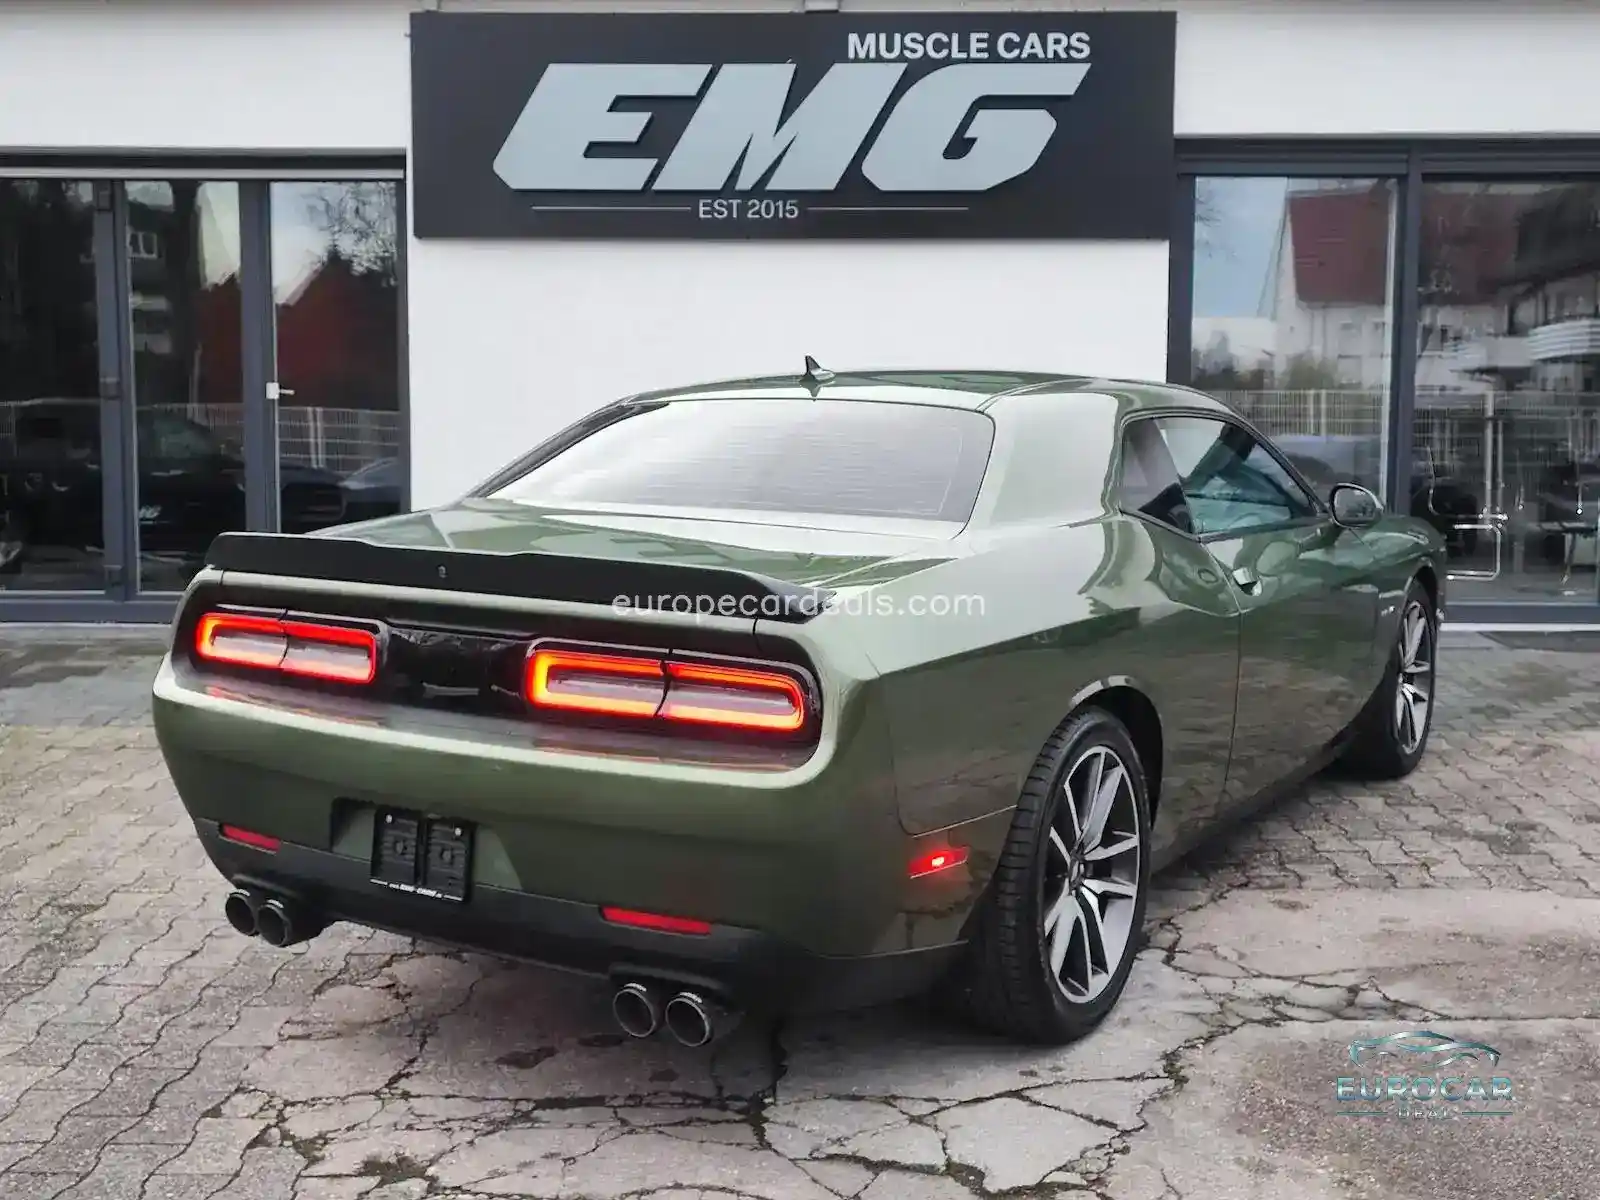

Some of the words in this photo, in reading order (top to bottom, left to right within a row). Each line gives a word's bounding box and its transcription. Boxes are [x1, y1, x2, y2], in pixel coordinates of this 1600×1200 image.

[847, 32, 990, 60] MUSCLE
[996, 32, 1091, 59] CARS
[493, 62, 1092, 192] EMG
[698, 199, 742, 219] EST
[746, 199, 799, 220] 2015
